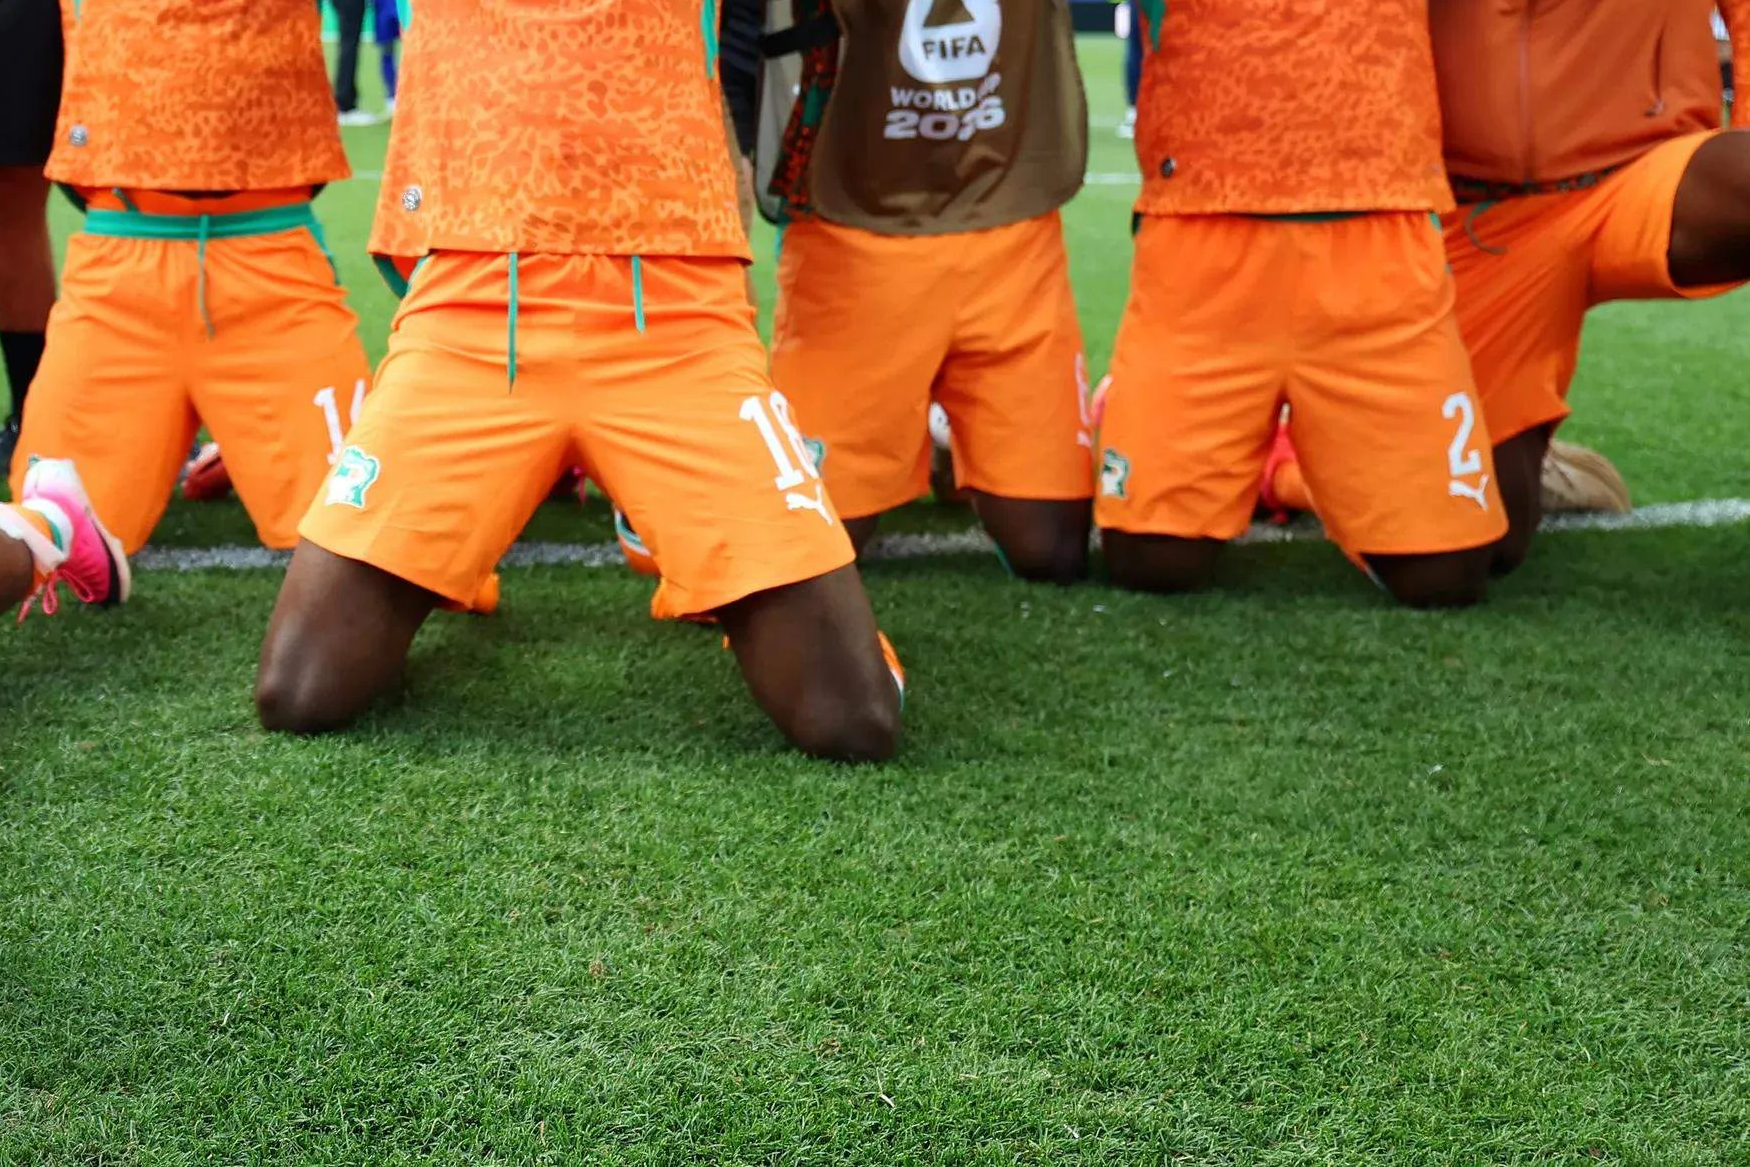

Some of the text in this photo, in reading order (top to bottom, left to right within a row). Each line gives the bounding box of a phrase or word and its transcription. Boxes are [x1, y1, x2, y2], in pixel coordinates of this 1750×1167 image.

[922, 35, 987, 61] FIFA
[890, 86, 977, 112] WORLD
[1441, 391, 1482, 477] 2
